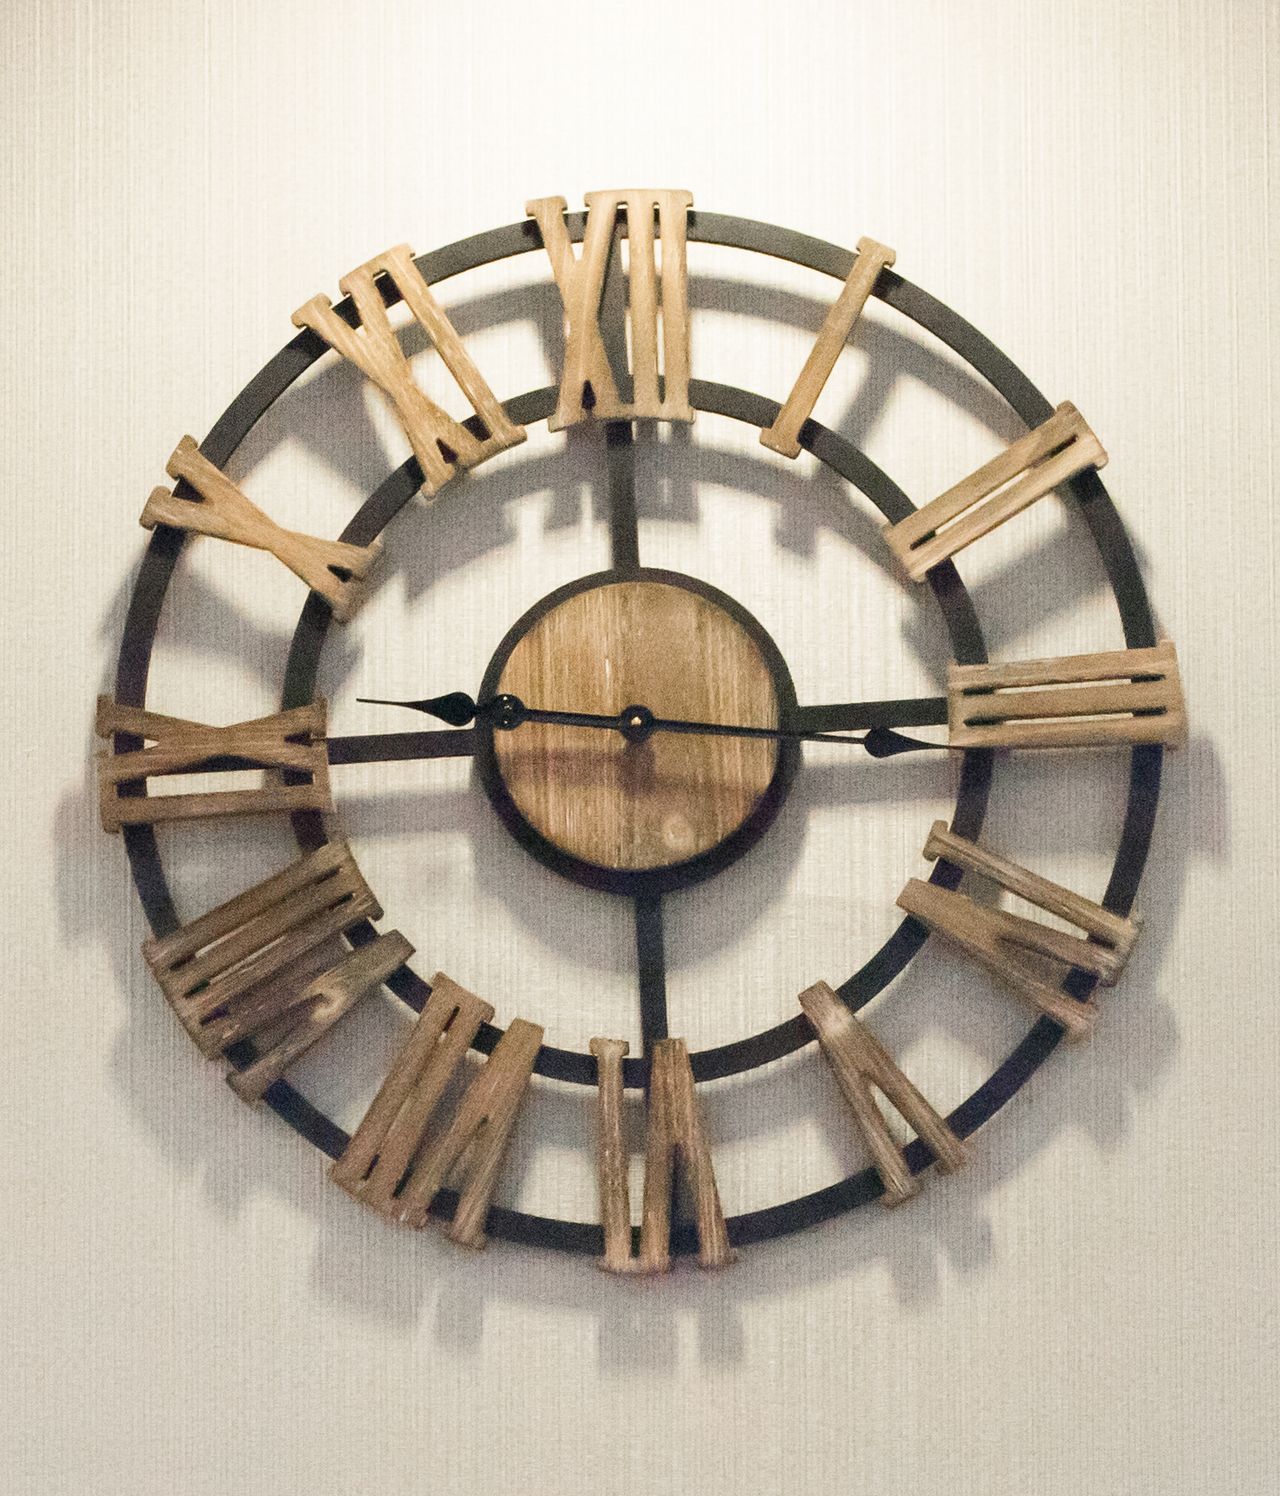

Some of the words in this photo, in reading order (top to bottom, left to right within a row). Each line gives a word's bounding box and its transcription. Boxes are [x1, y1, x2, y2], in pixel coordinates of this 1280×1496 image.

[291, 243, 527, 499] XI
[526, 189, 694, 431] XII
[140, 436, 384, 621] X
[883, 401, 1109, 581] II
[96, 693, 337, 833] IX
[948, 640, 1186, 749] III
